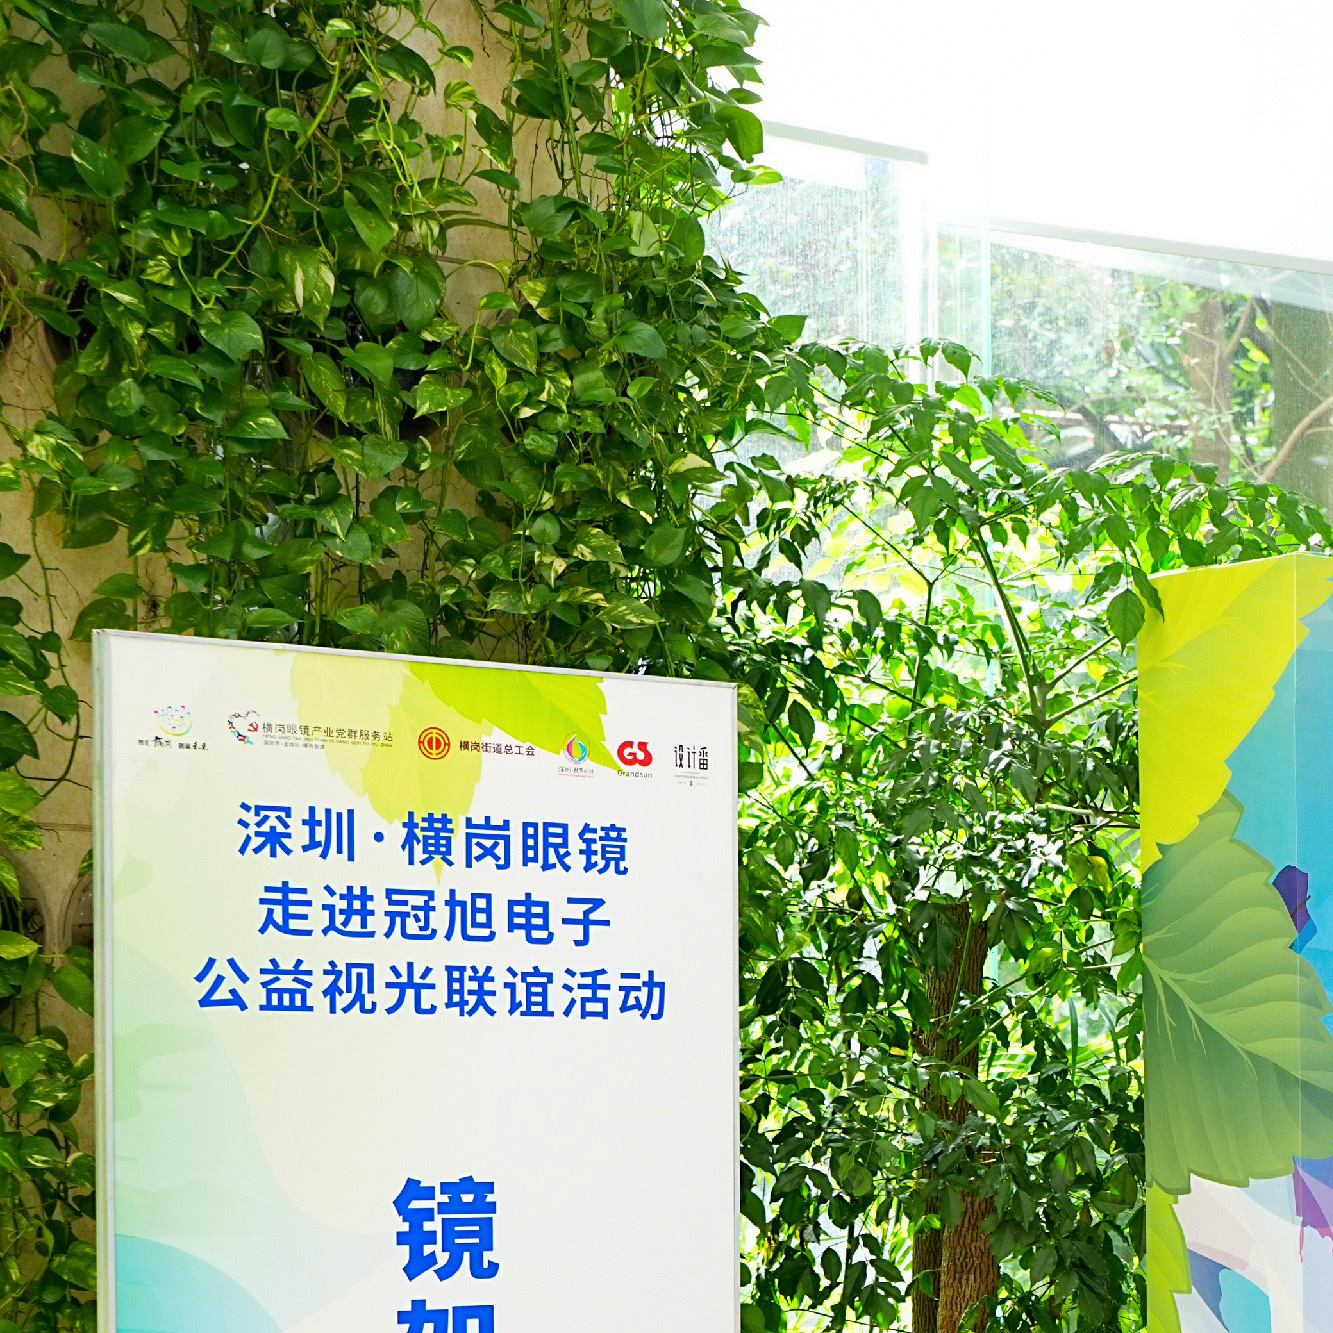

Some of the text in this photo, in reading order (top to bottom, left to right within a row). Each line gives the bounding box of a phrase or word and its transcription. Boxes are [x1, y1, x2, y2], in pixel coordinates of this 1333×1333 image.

[262, 722, 393, 742] 横岗眼镜产业党群服务站
[459, 740, 536, 757] 横岗街道总工会
[617, 770, 653, 779] Grandsun
[237, 802, 628, 875] 深圳·横岗眼镜
[258, 881, 611, 947] 走进冠旭电子
[193, 956, 667, 1021] 公益视光联谊活动
